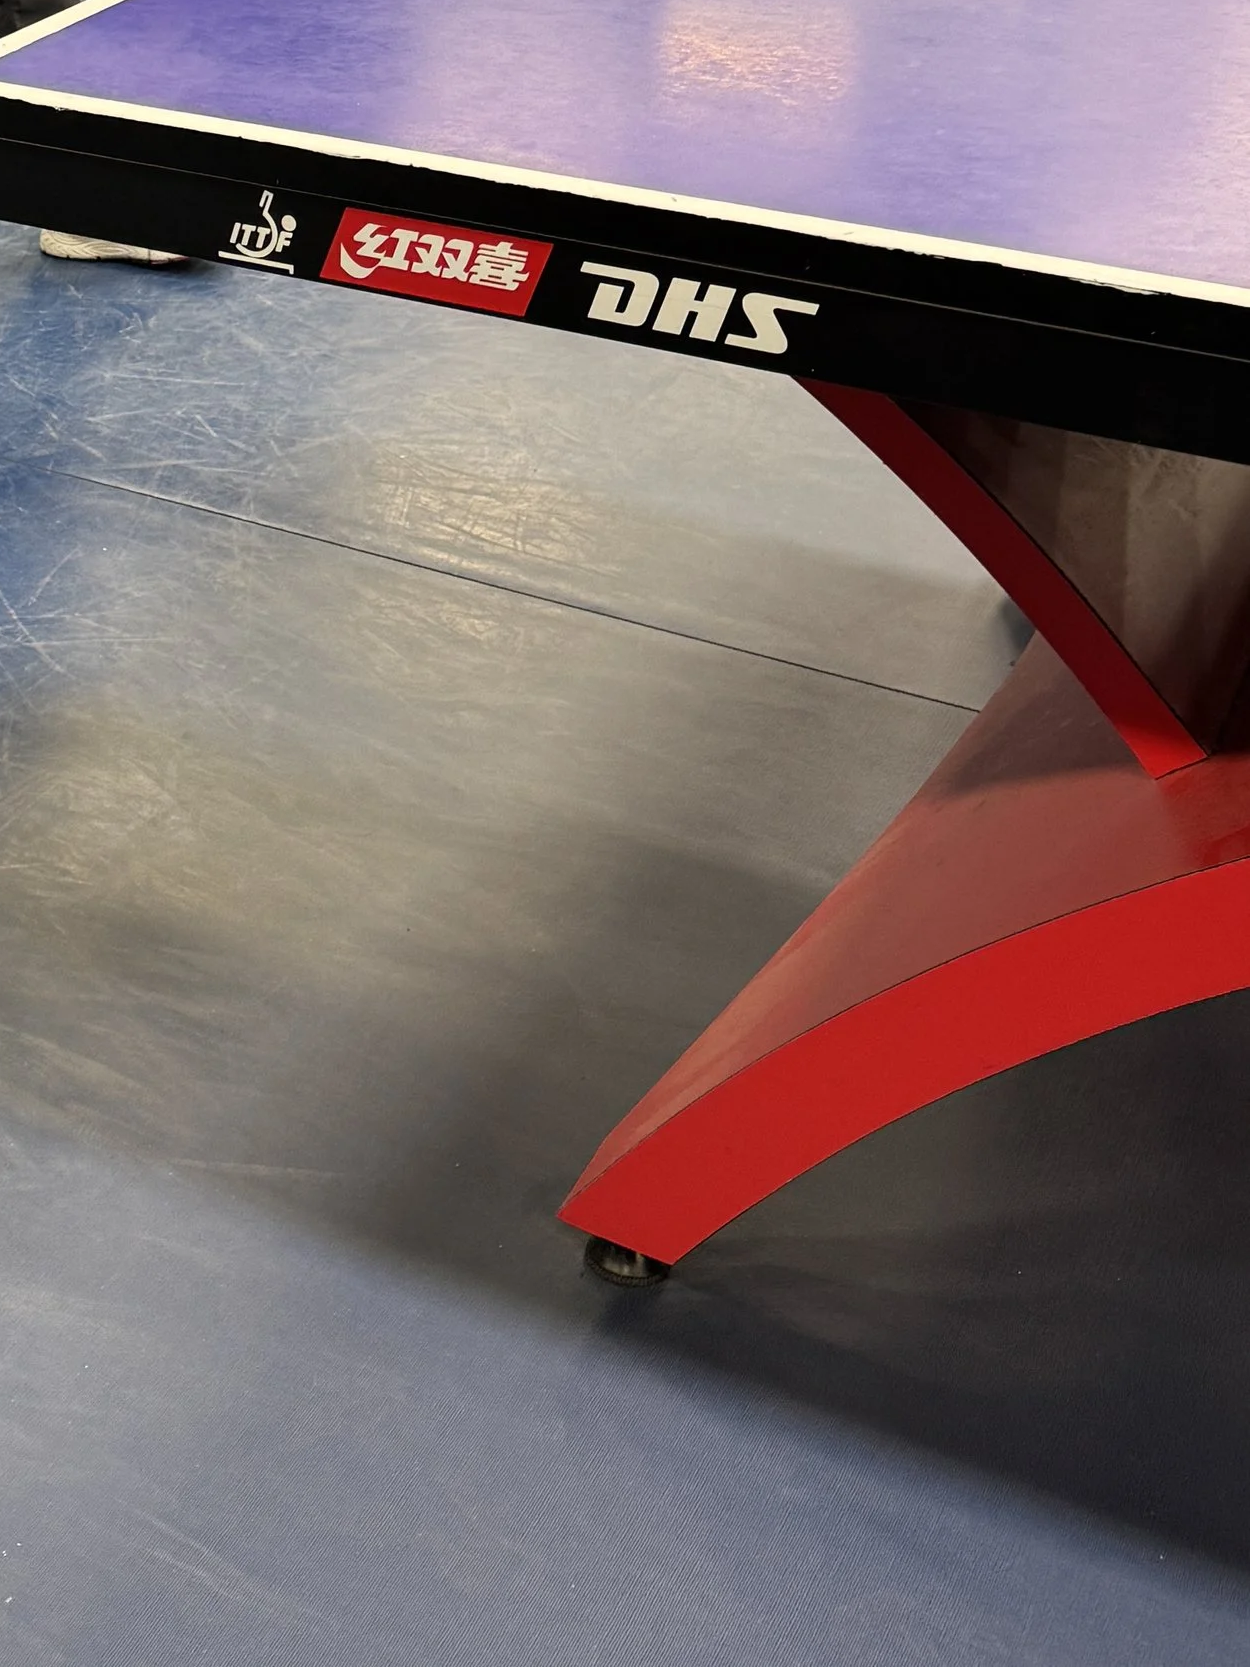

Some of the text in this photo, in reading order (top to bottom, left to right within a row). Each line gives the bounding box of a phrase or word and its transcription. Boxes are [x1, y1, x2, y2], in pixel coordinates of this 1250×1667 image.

[229, 221, 293, 254] ITTF
[340, 222, 530, 291] 红双喜
[580, 261, 820, 354] DHS
